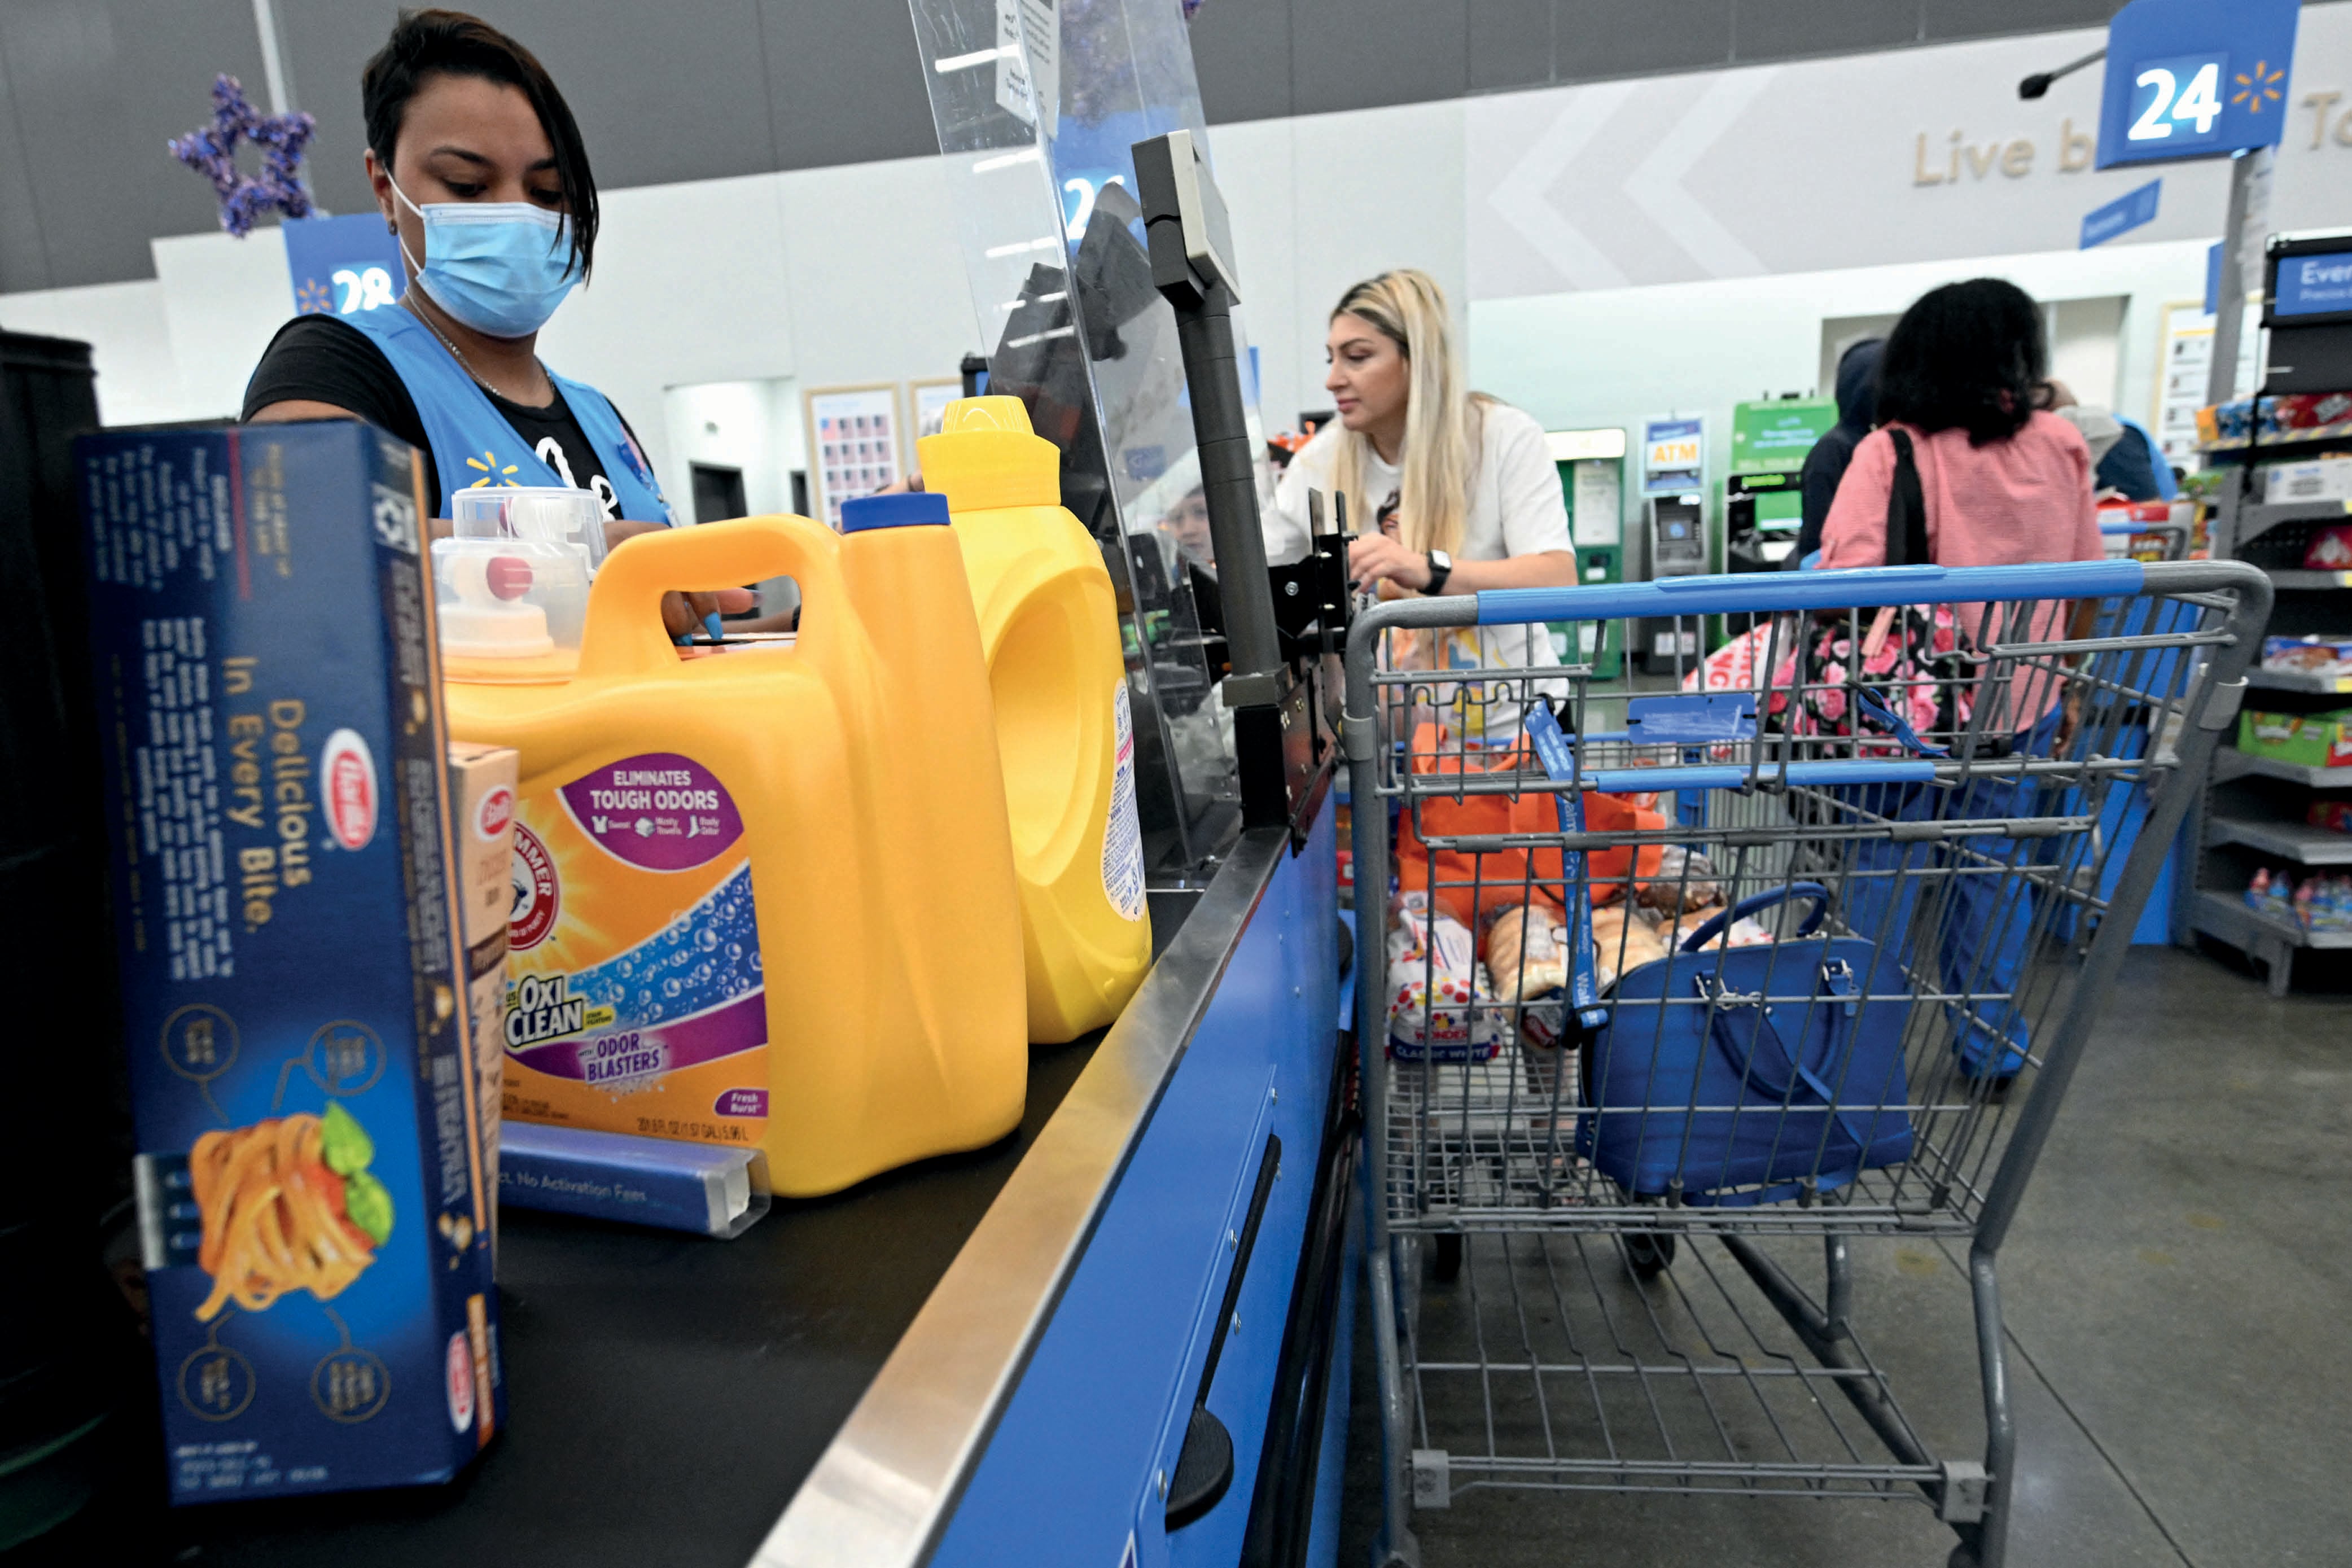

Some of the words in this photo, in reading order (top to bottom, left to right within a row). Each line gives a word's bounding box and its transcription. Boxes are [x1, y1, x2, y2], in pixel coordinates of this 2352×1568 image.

[2126, 62, 2223, 141] 24
[1913, 129, 2034, 187] Live
[1065, 175, 1124, 240] 2
[332, 267, 395, 314] 28
[1652, 444, 1698, 463] ATM
[222, 656, 259, 695] In
[226, 713, 266, 830] Every
[613, 770, 692, 786] ELIMINATES
[268, 698, 314, 888] Delicious
[590, 790, 651, 810] TOUGH
[654, 790, 720, 811] ODORS
[514, 830, 555, 897] MMER
[519, 975, 564, 1014] OXI
[506, 998, 583, 1046] CLEAN
[588, 1049, 659, 1081] BLASTERS
[598, 1033, 640, 1058] ODOR
[731, 1093, 759, 1103] Fresh
[516, 1171, 538, 1188] No
[540, 1174, 612, 1198] Activation
